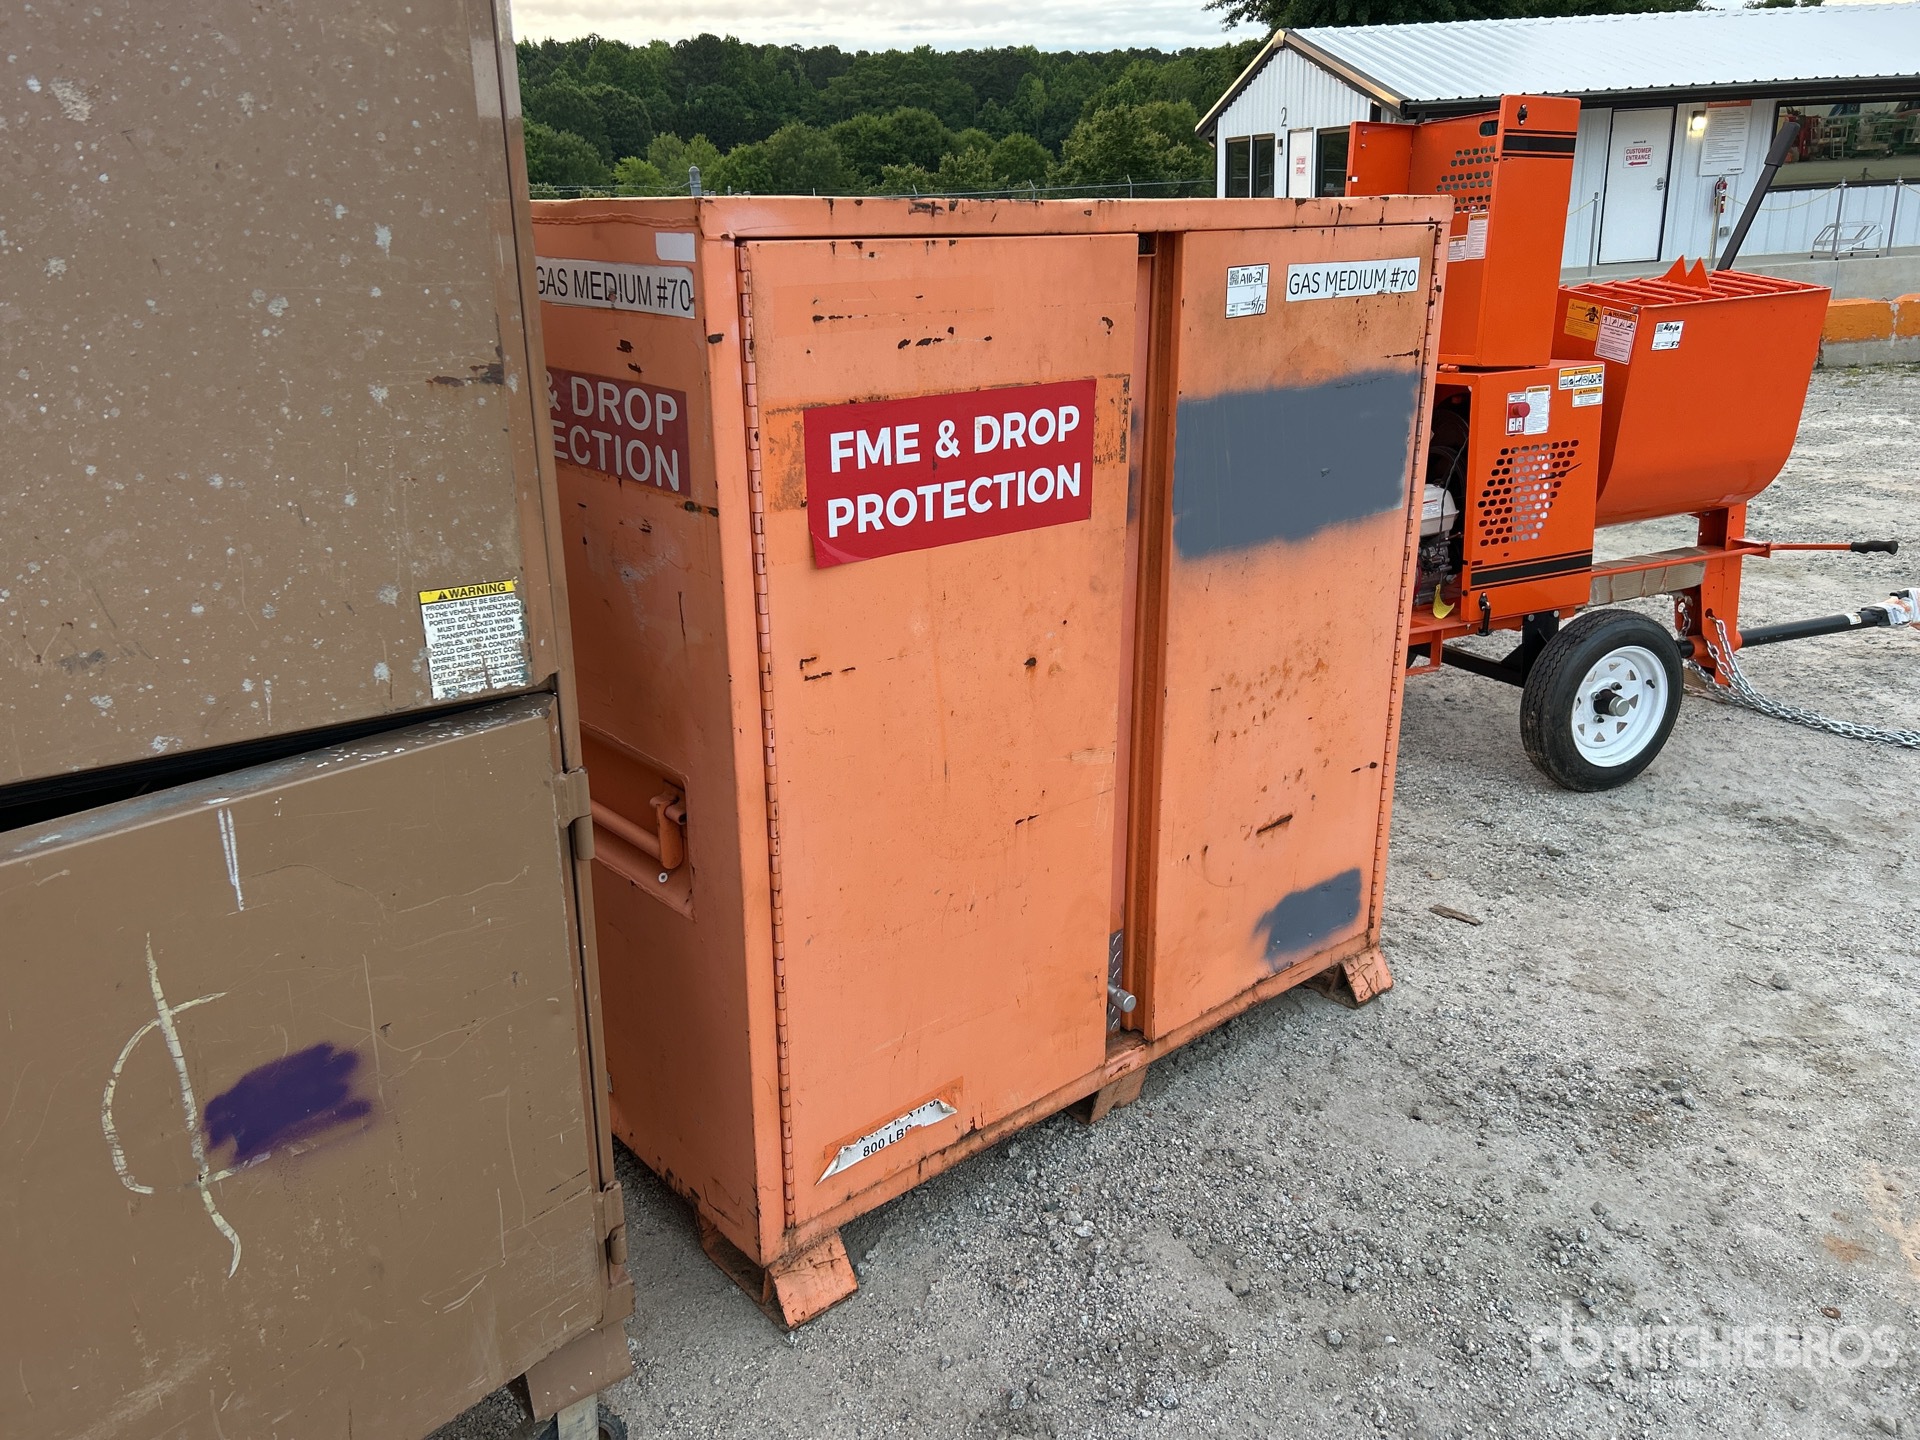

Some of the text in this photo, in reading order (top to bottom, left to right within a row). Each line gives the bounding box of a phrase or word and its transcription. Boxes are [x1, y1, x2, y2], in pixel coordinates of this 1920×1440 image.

[1281, 107, 1287, 127] 2
[1289, 267, 1416, 295] GAS MEDIUM #70
[538, 266, 692, 312] GAS MEDIUM #70
[571, 376, 677, 436] DROP
[830, 405, 1080, 473] FME & DROP
[827, 462, 1081, 538] PROTECTION
[448, 583, 505, 598] WARNING
[425, 602, 458, 611] PRODUCT
[449, 607, 476, 615] VEHICLE
[457, 614, 481, 622] COVER
[436, 625, 455, 633] MUST
[467, 620, 493, 628] LOCKED
[437, 628, 488, 640] TRANSPORTING
[431, 648, 454, 656] COULD
[455, 644, 481, 652] CREAT
[432, 655, 457, 664] WHERE
[471, 648, 501, 657] PRODUCT
[451, 659, 481, 668] CAUSING
[863, 1137, 885, 1157] 800
